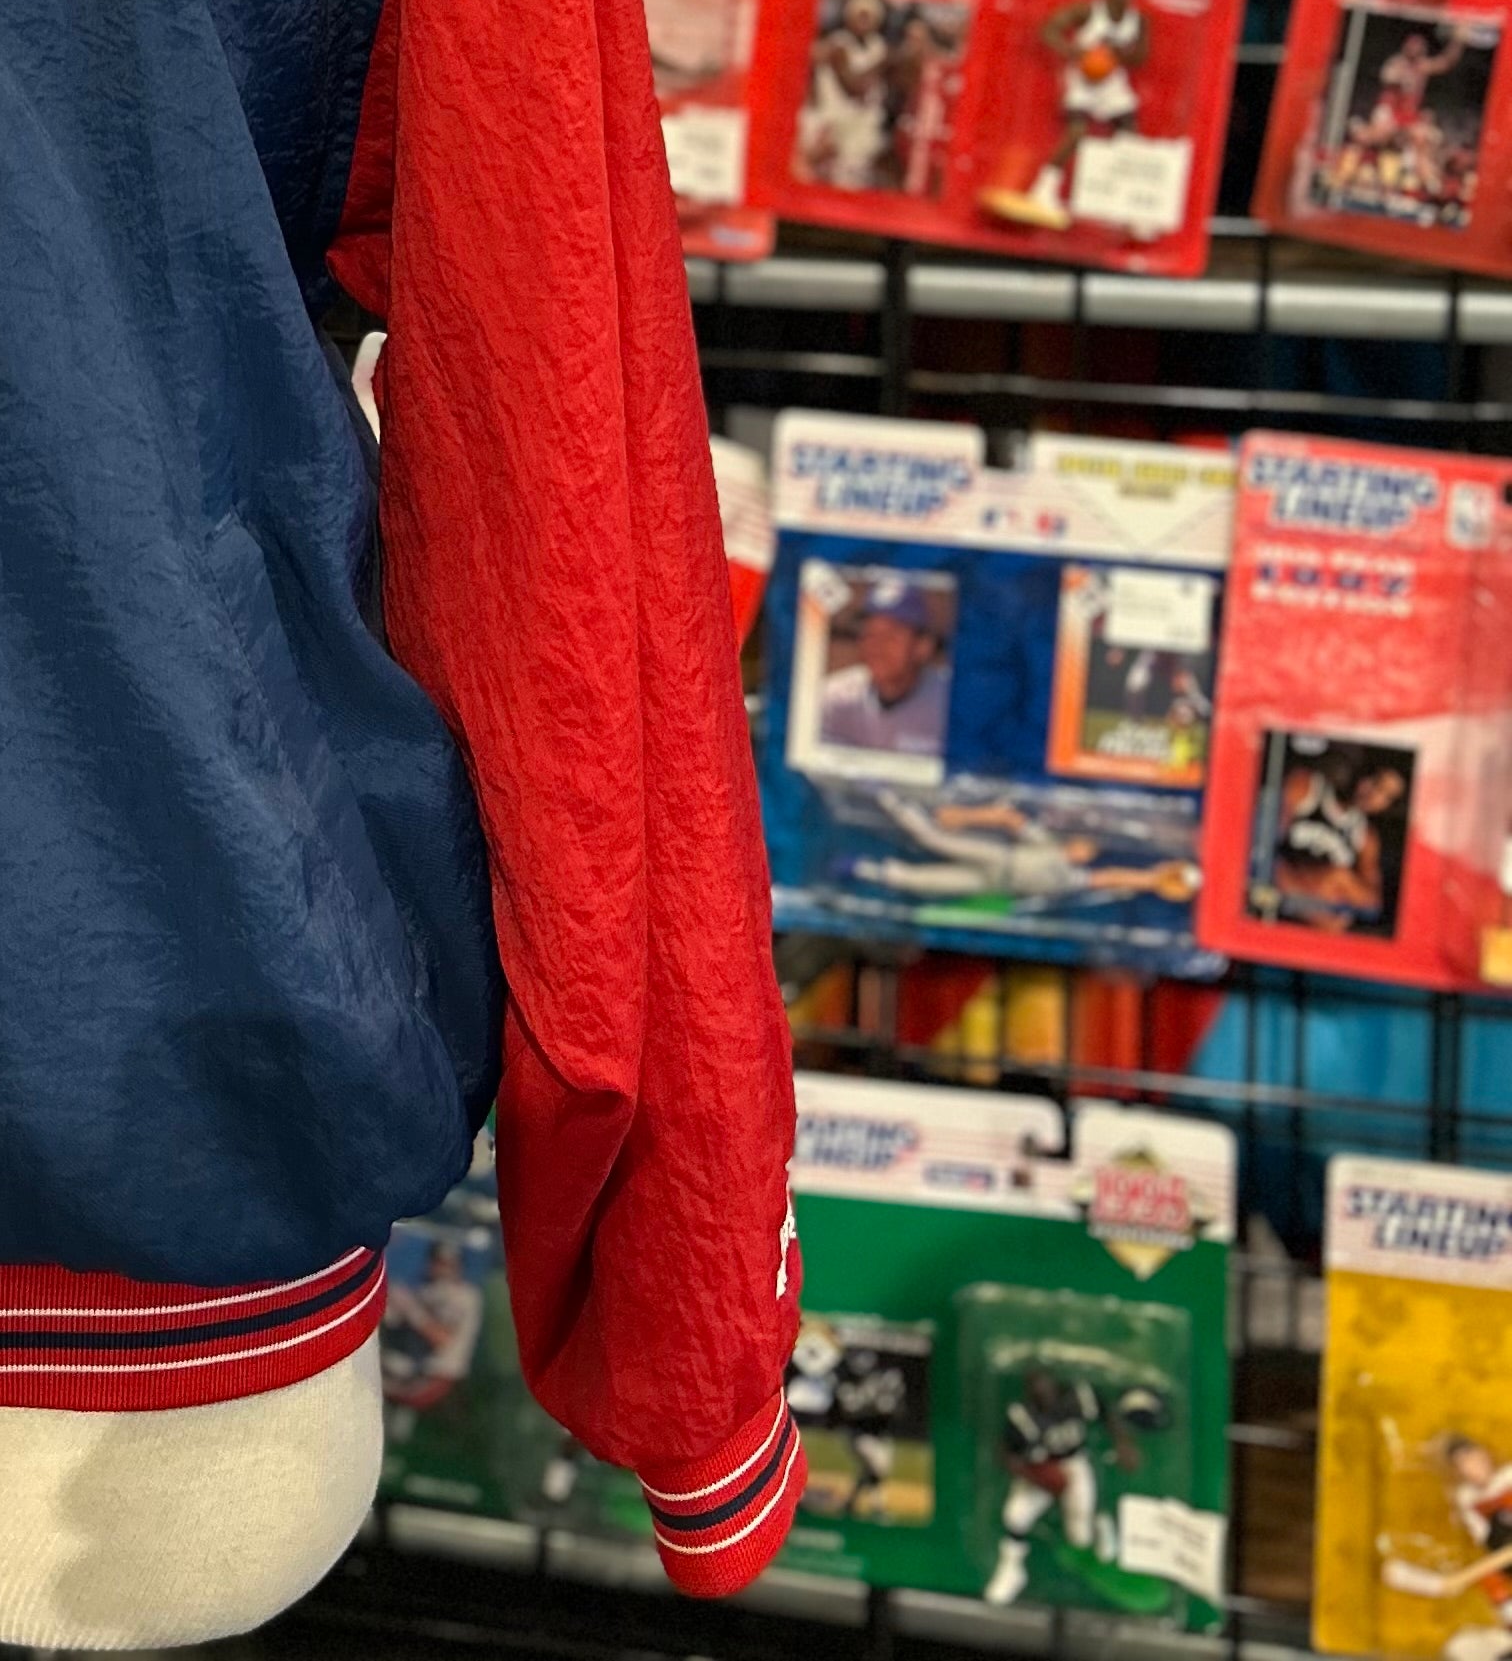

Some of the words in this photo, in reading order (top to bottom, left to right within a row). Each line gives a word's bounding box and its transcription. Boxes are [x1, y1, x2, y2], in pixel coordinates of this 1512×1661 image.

[792, 445, 972, 493] STARTING
[1251, 455, 1437, 507] STARTING
[818, 471, 947, 518] LINEUP
[1274, 482, 1411, 534] LINEUP
[797, 1113, 918, 1151] ARTING
